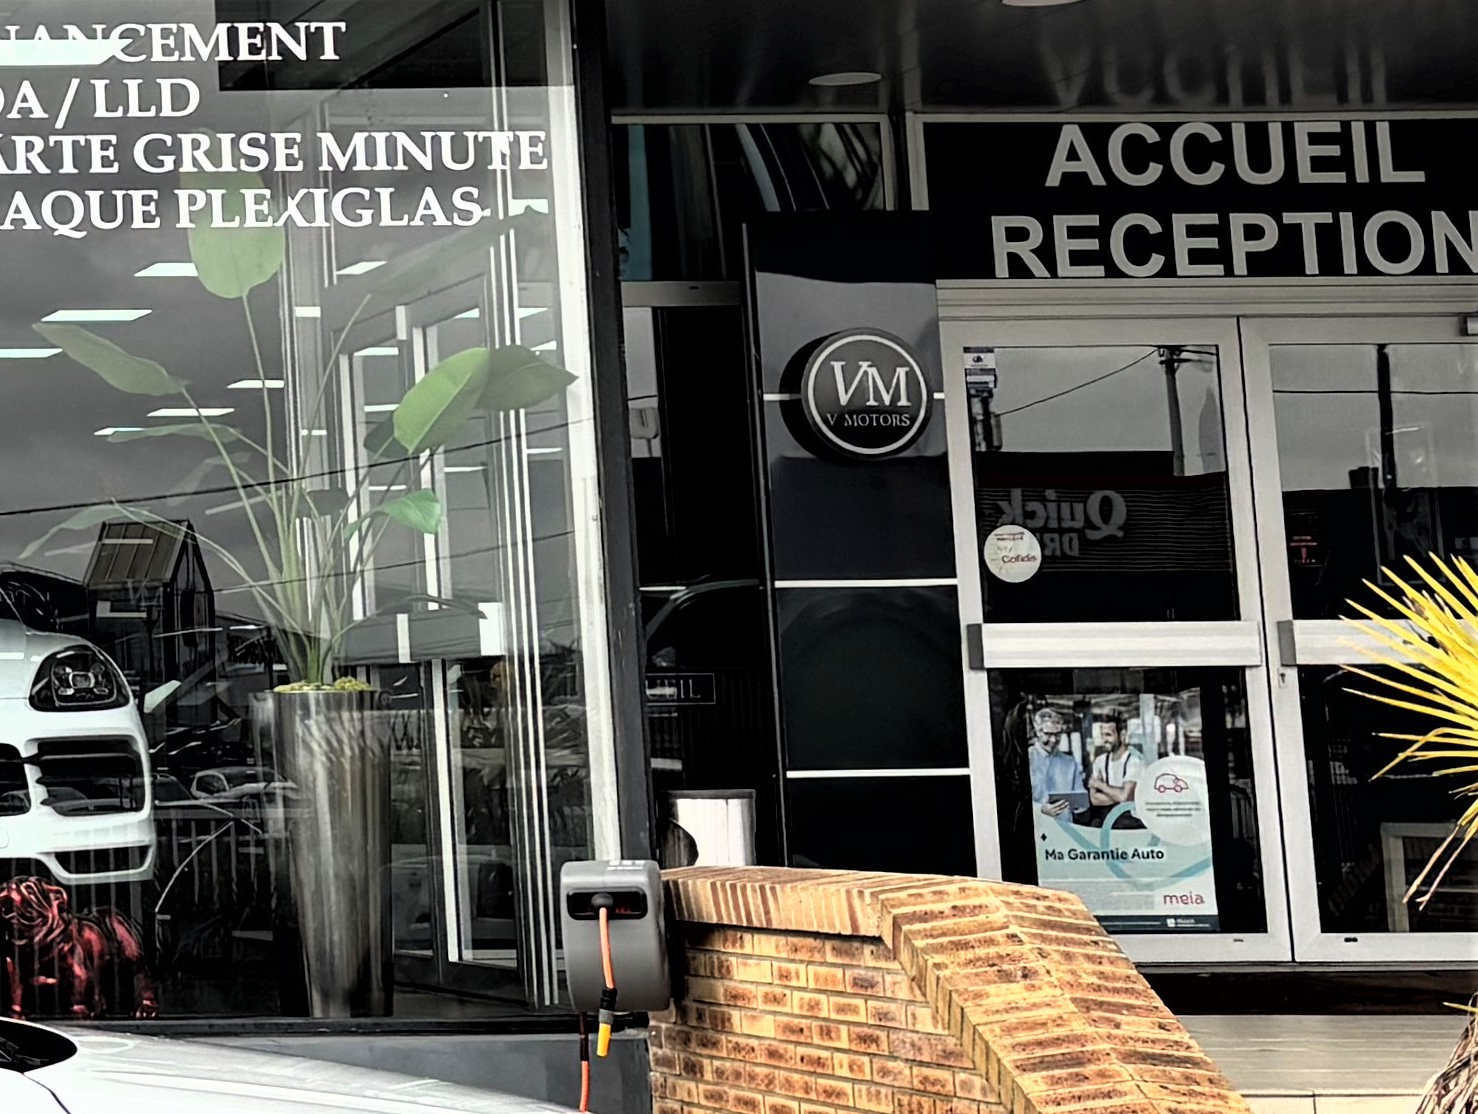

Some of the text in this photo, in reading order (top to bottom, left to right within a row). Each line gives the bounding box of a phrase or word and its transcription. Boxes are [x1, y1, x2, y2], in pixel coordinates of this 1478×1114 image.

[90, 78, 200, 118] LLD
[133, 132, 303, 174] GRISE
[316, 131, 548, 171] MINUTE
[1045, 121, 1425, 186] ACCUEIL
[175, 186, 480, 230] PLEXIGLAS
[990, 210, 1478, 278] RECEPTION
[830, 361, 911, 406] VM
[827, 413, 910, 427] V MOTORS
[1045, 848, 1164, 861] Ma Garantie Auto
